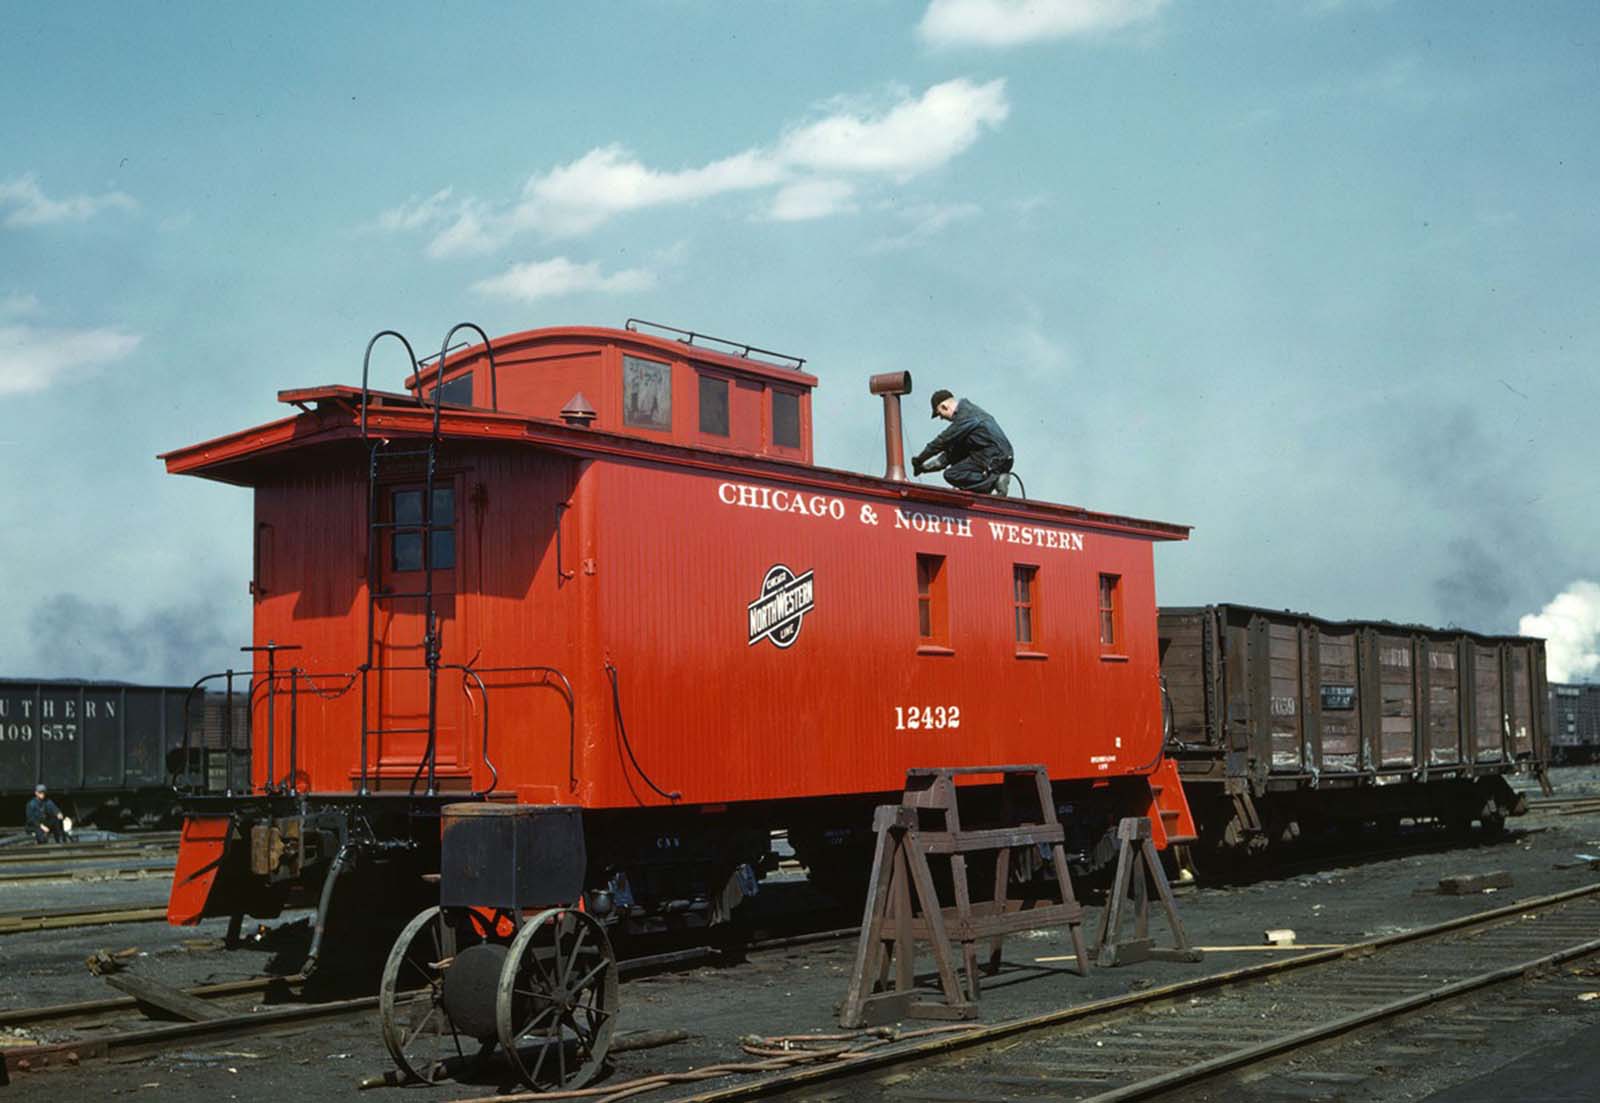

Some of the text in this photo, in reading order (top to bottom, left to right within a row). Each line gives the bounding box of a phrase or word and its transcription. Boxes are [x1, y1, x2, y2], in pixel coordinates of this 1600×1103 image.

[718, 482, 1085, 551] CHICAGO & NORTH WESTERN
[895, 705, 960, 730] 12432
